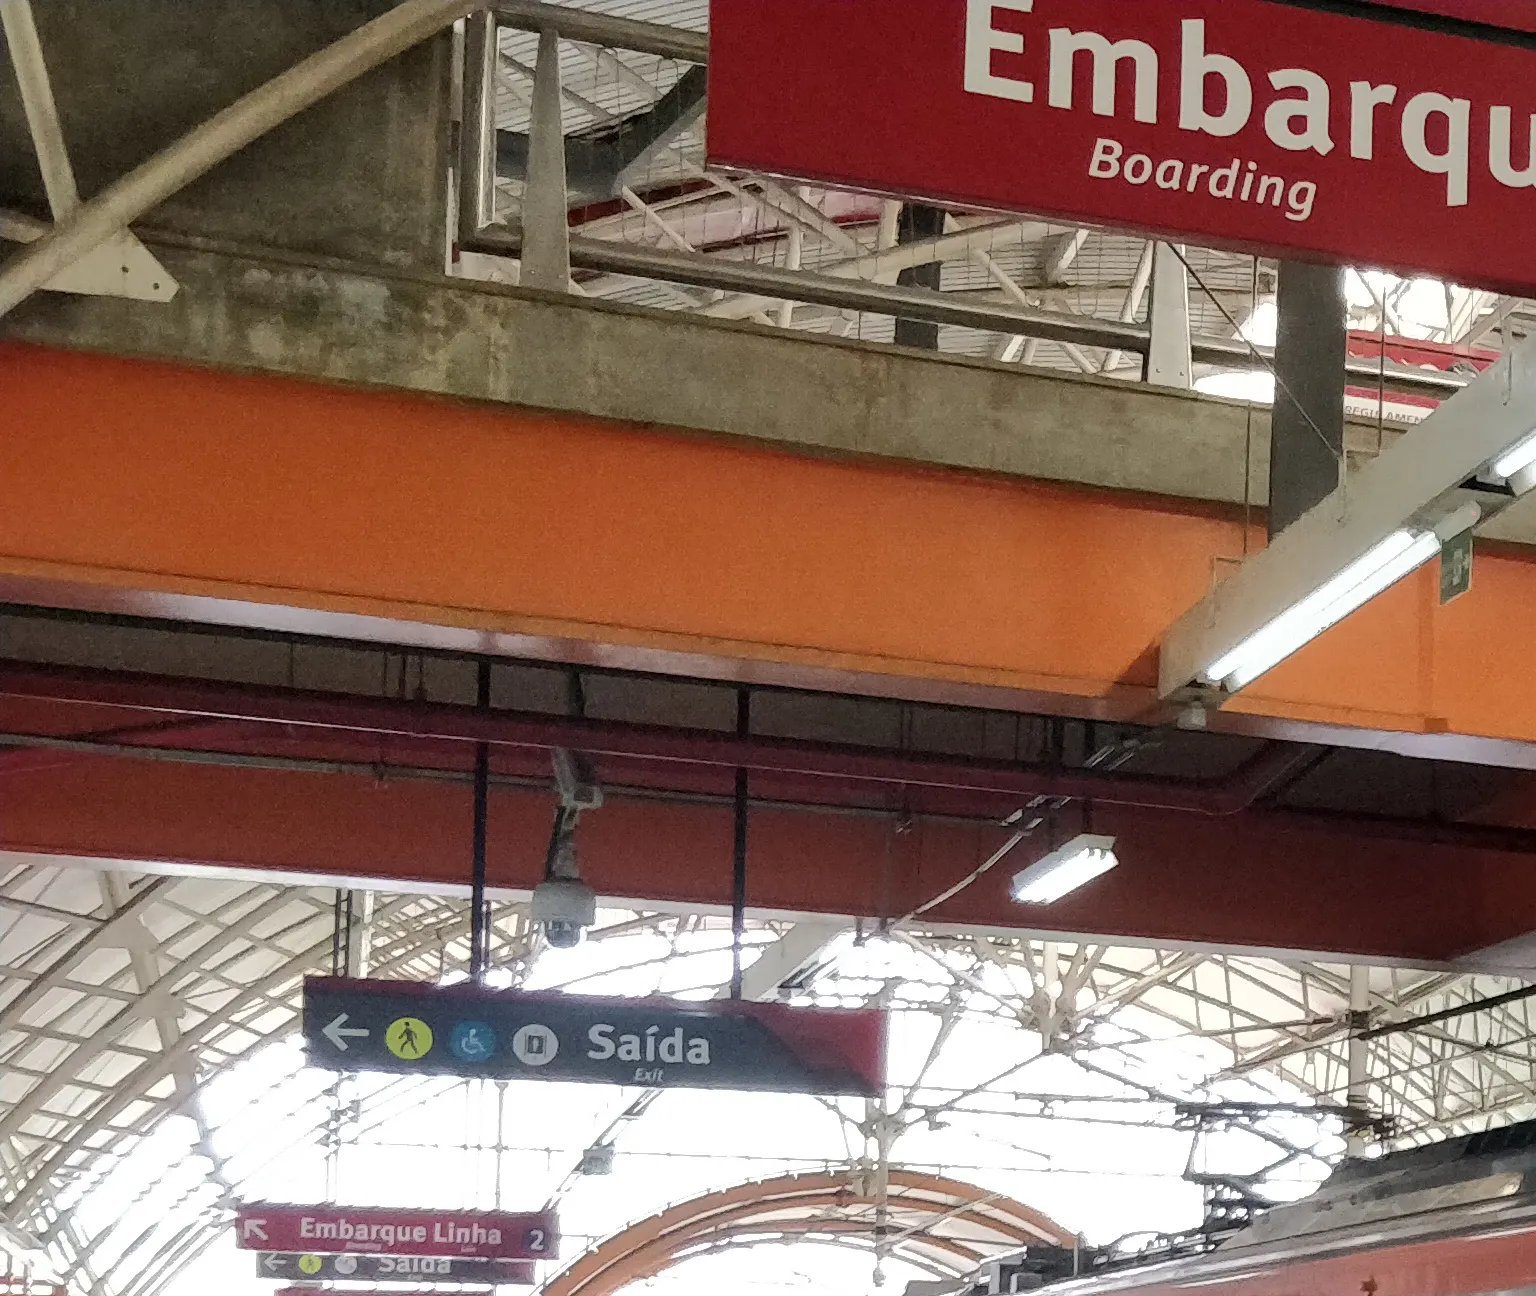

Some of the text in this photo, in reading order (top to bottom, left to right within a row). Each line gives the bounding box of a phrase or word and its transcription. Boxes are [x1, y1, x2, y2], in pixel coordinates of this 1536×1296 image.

[1088, 137, 1318, 222] Boarding
[587, 1022, 711, 1066] Saída
[633, 1067, 665, 1083] Exit
[300, 1216, 428, 1247] Embarque
[434, 1222, 502, 1246] Linha
[530, 1229, 544, 1251] 2
